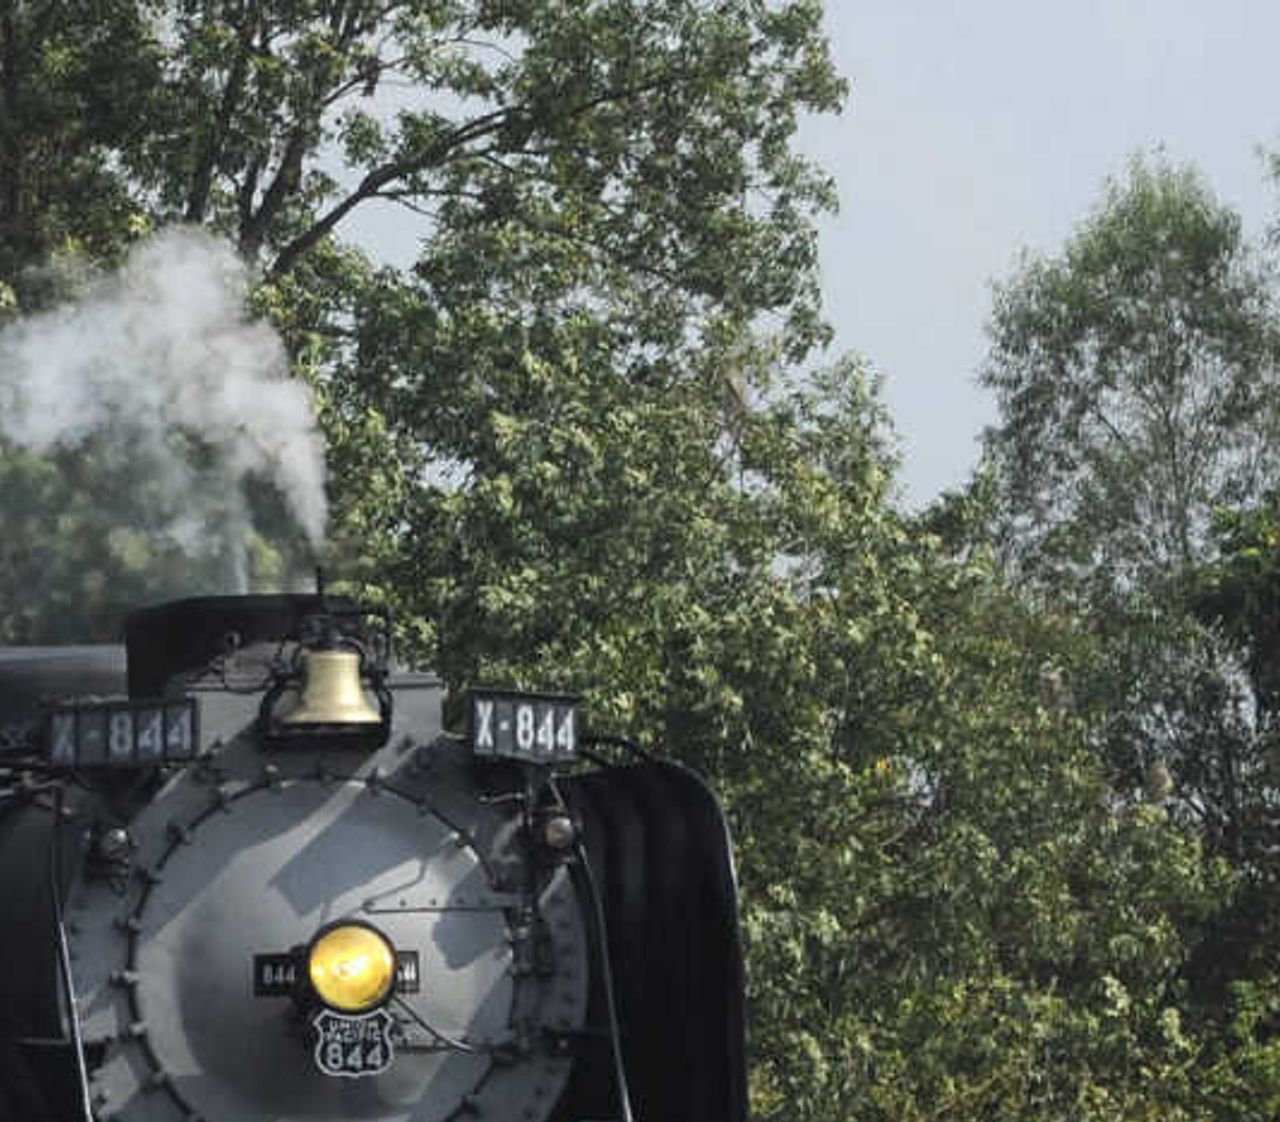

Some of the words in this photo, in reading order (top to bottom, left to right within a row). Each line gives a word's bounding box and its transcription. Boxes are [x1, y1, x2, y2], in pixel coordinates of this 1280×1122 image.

[51, 708, 191, 758] X-844
[477, 700, 575, 752] X-844
[263, 963, 295, 985] 844
[327, 1042, 382, 1070] 844
